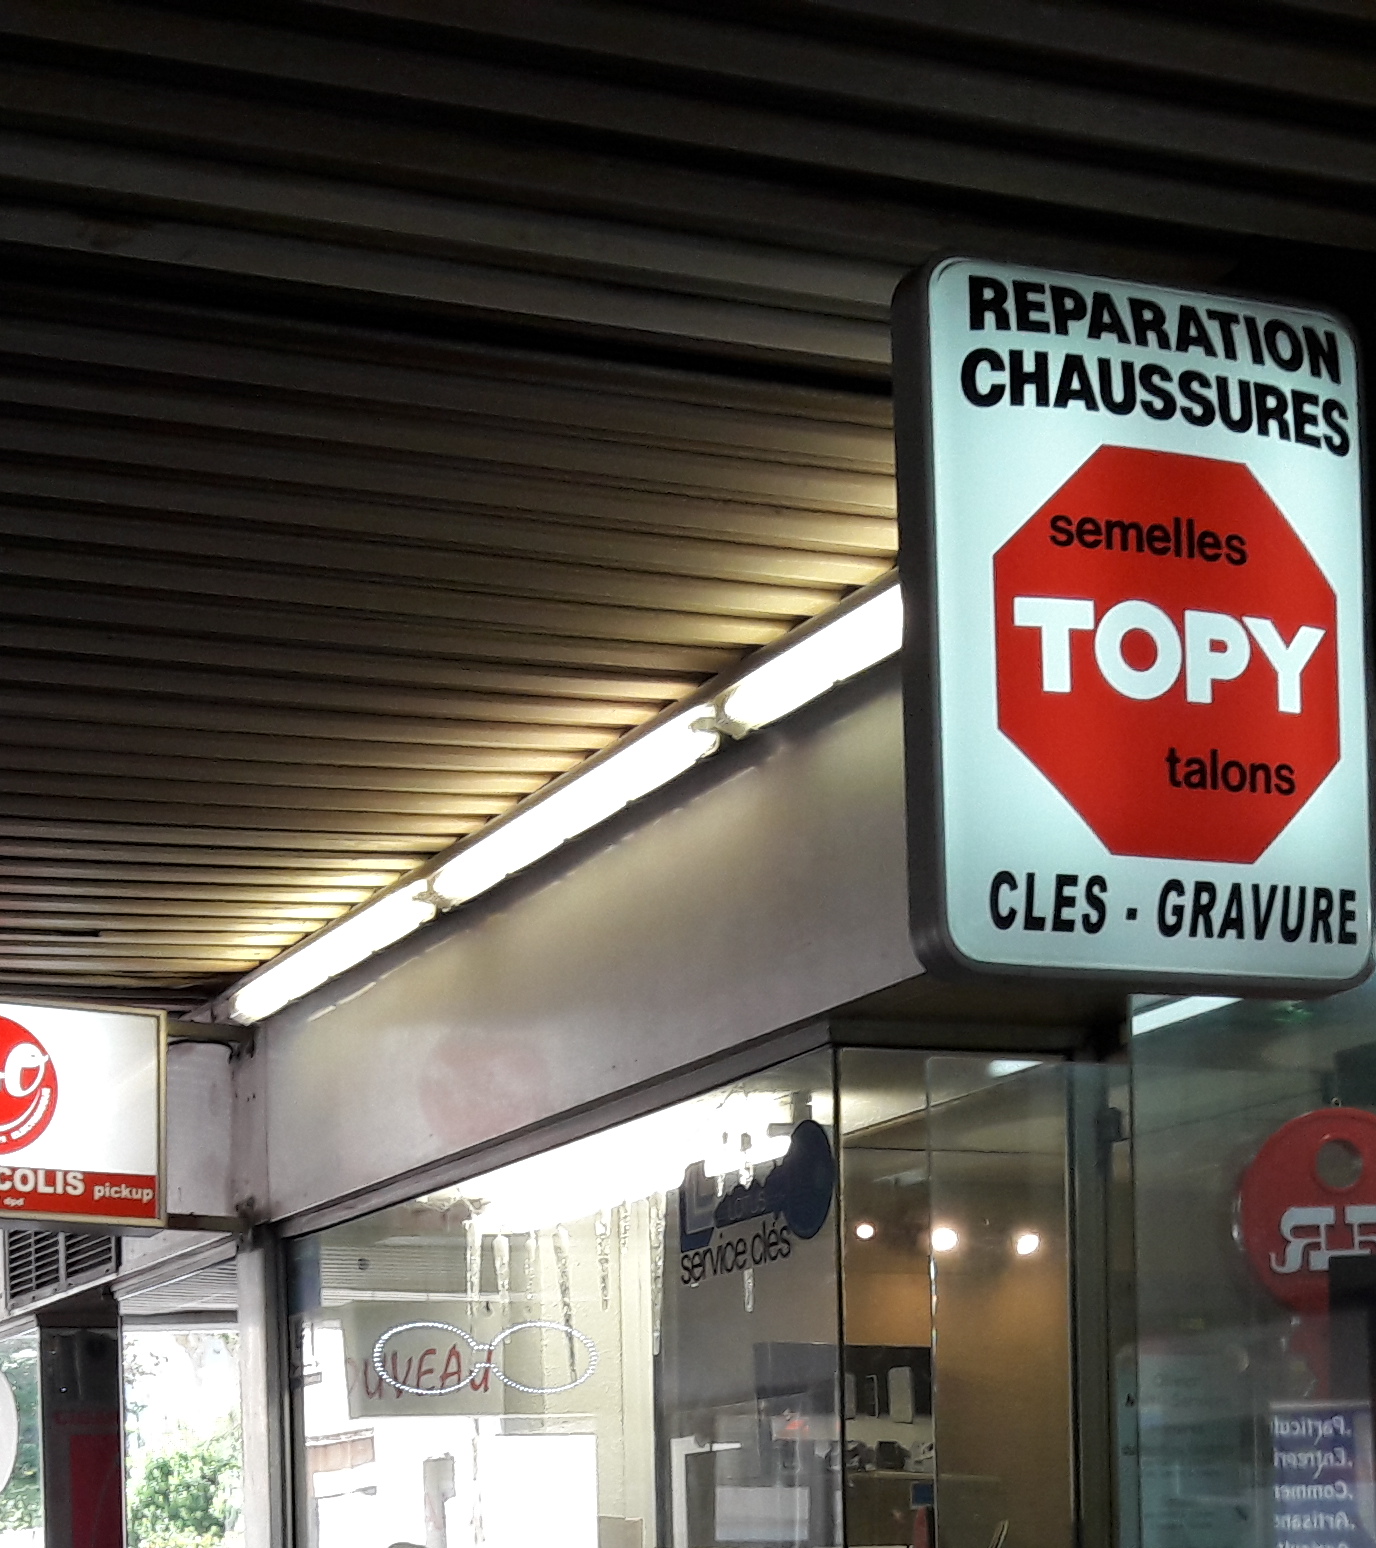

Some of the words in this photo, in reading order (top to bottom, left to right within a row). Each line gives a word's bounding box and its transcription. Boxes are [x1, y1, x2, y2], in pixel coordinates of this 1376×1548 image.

[969, 276, 1340, 383] REPARATION
[961, 347, 1351, 456] CHAUSSURES
[1050, 515, 1247, 565] semelles
[1012, 597, 1325, 713] TOPY
[1167, 747, 1295, 794] talons
[990, 871, 1107, 934] CLES
[1158, 880, 1358, 944] GRAVURE
[93, 1182, 155, 1204] pickup
[680, 1232, 748, 1286] service
[750, 1216, 792, 1266] clés
